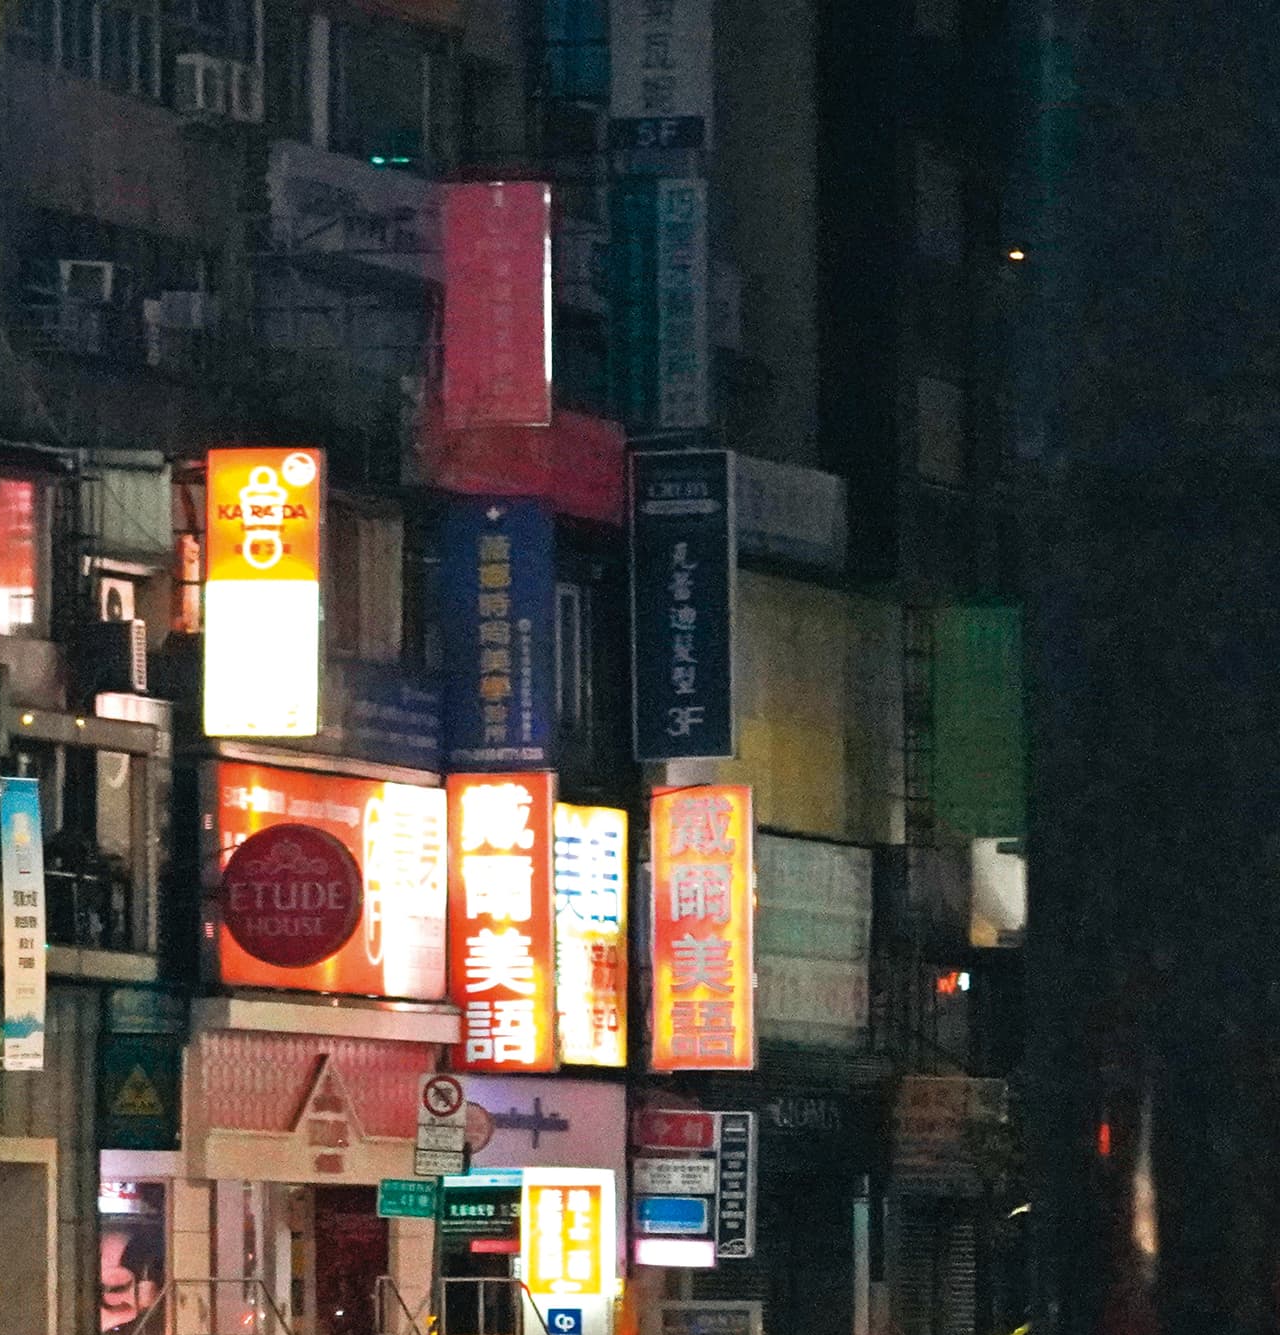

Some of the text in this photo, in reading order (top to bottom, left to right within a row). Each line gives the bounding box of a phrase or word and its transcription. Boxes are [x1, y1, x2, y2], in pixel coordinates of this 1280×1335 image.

[665, 705, 706, 738] 3F
[230, 880, 345, 911] ETUDE
[246, 916, 325, 937] HOUSE
[462, 784, 535, 1064] 戴爾美語
[669, 796, 737, 1059] 戴爾美語
